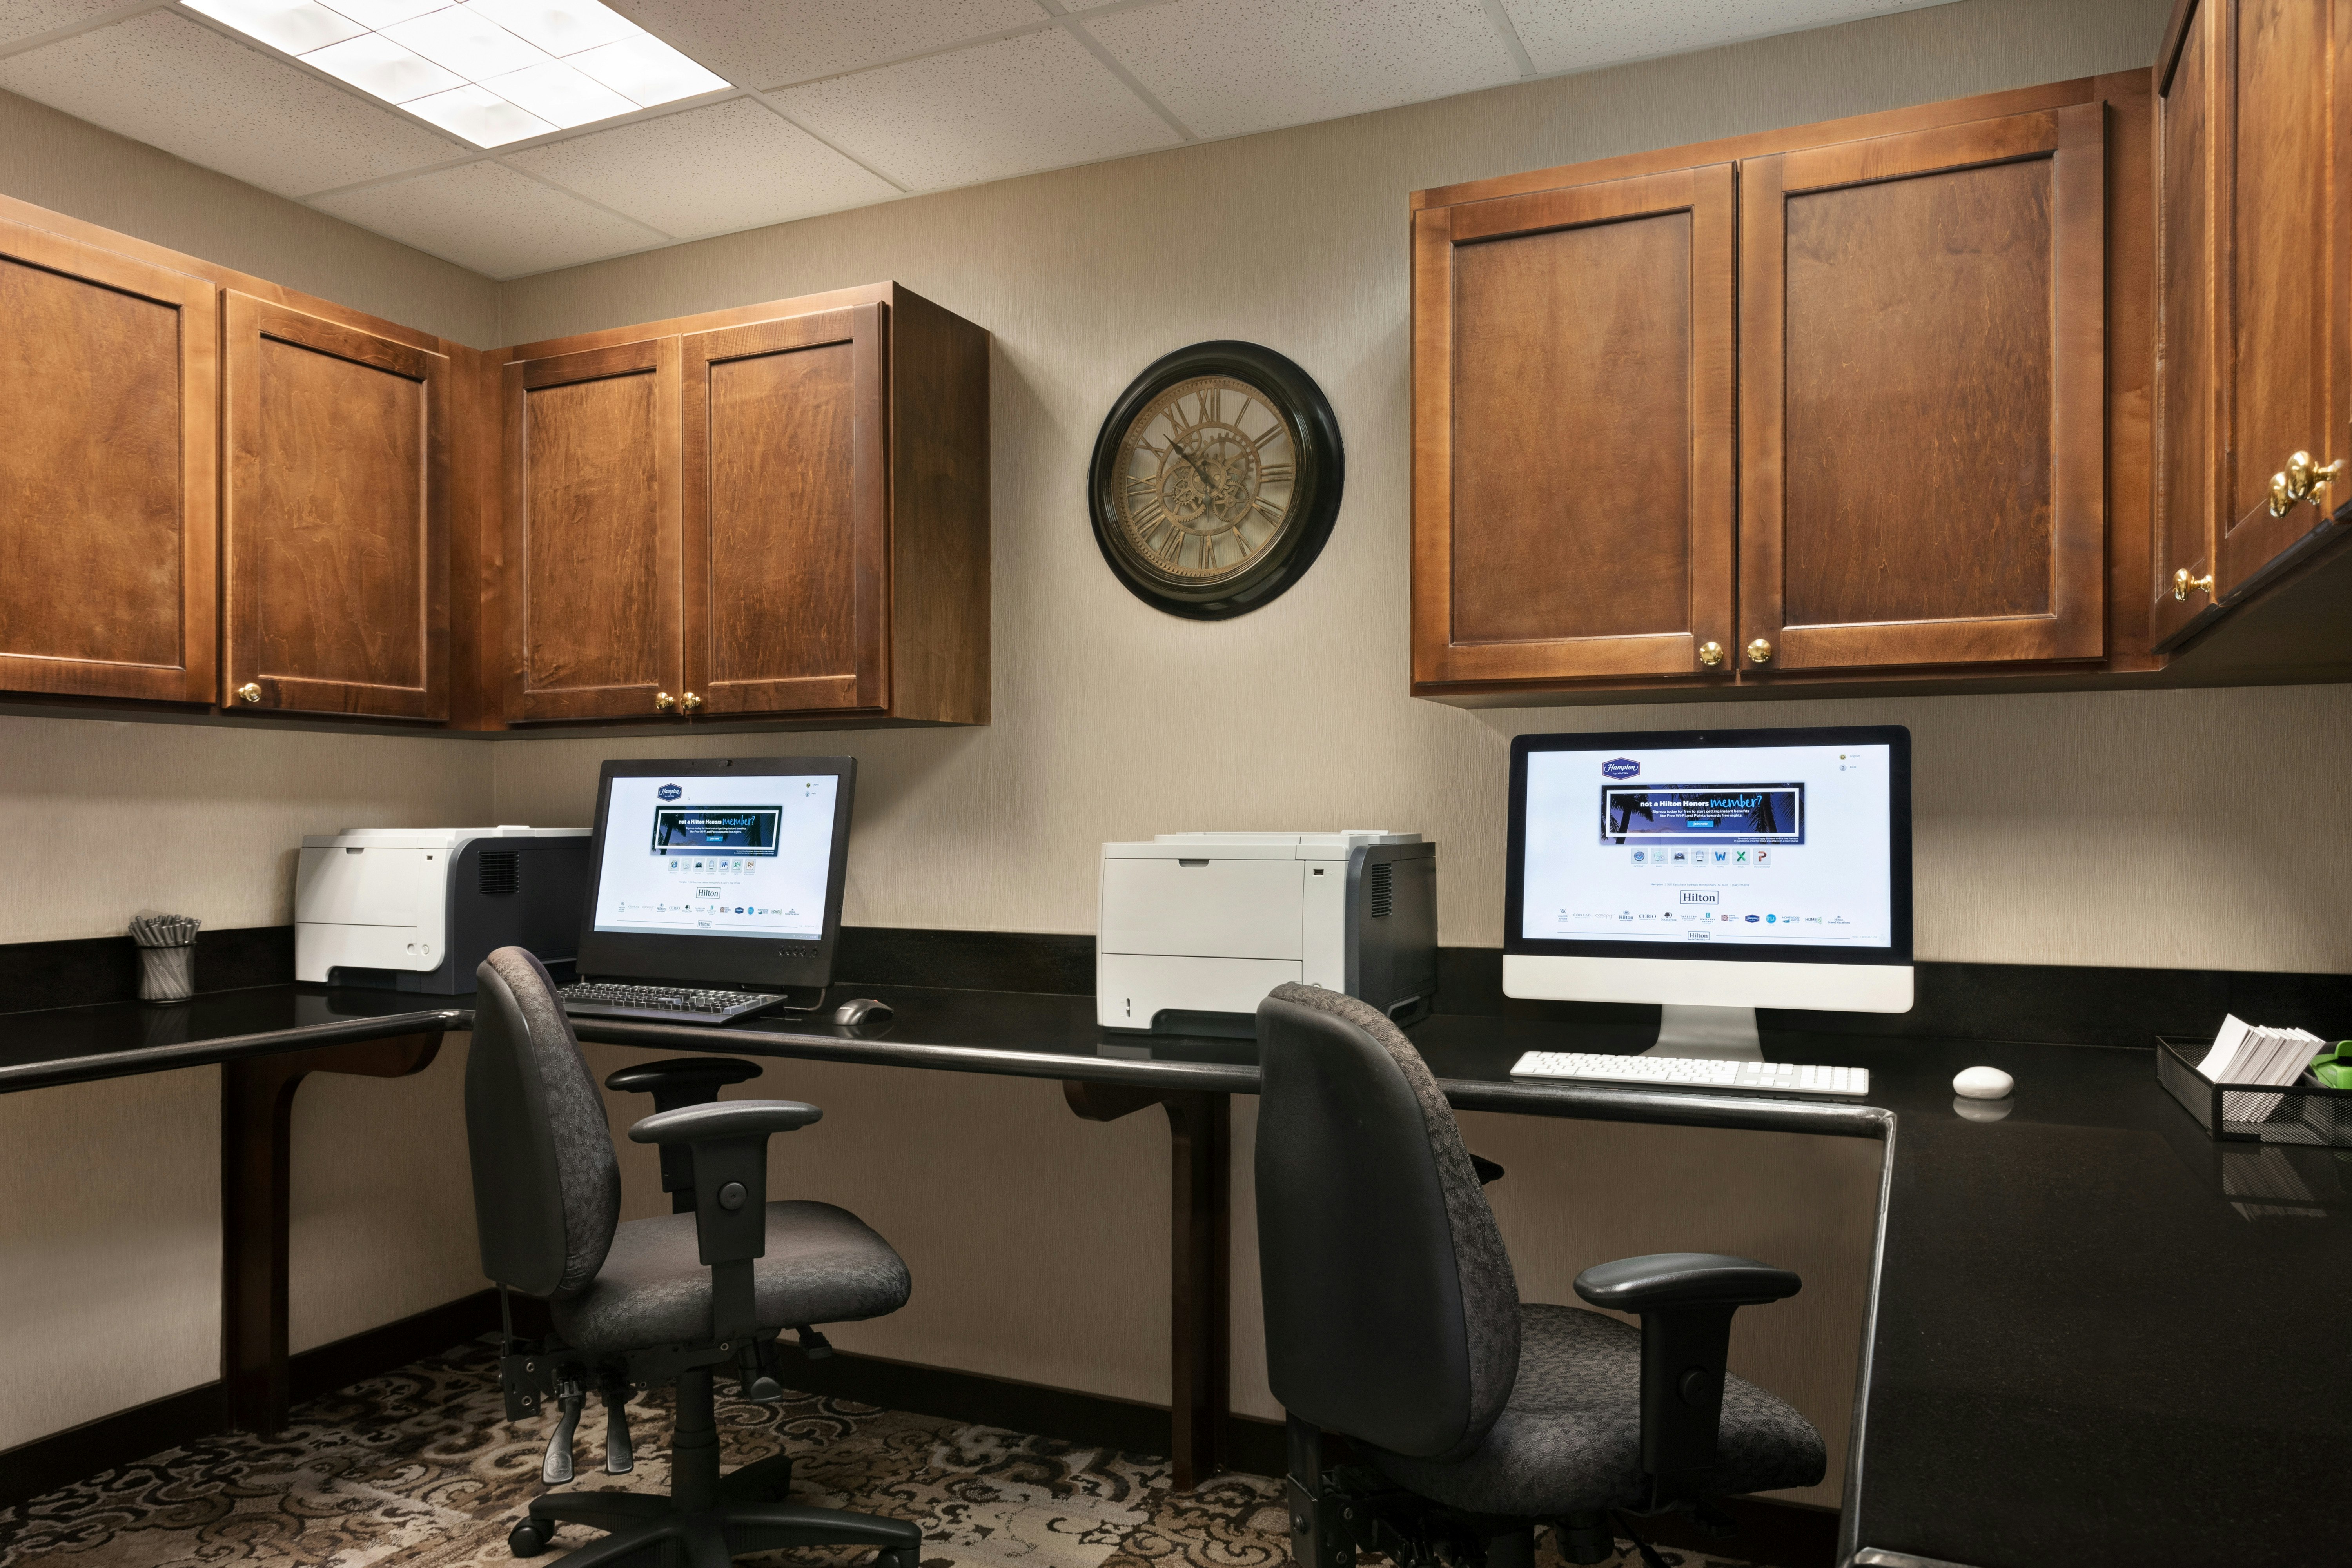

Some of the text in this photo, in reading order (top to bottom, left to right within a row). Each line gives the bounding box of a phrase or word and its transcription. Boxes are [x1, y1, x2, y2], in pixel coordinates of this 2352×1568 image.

[1604, 764, 1638, 772] Hampton
[1710, 794, 1762, 808] member?
[722, 815, 755, 826] member?
[1715, 851, 1726, 861] W
[1737, 851, 1746, 862] X
[1758, 851, 1767, 862] P
[1683, 893, 1715, 902] Hilton
